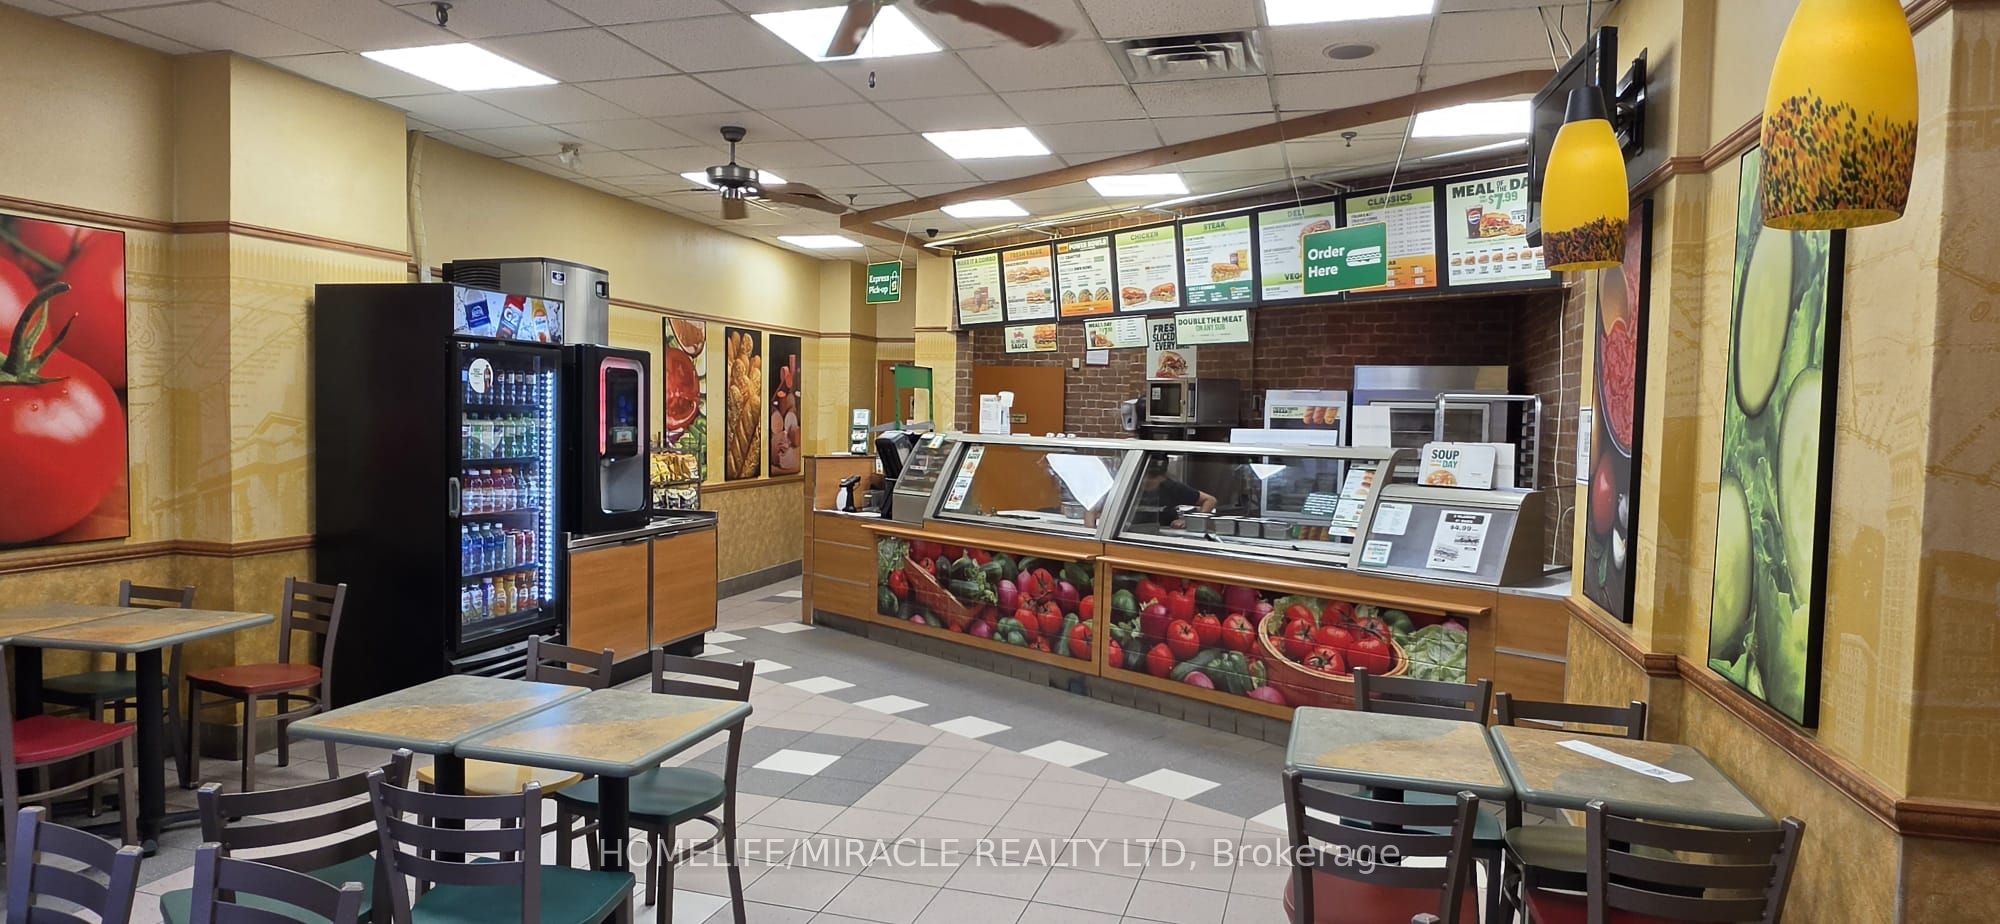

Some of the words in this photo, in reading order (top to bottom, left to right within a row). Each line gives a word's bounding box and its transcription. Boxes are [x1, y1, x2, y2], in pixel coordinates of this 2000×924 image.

[1452, 181, 1495, 199] MEAL
[1509, 176, 1529, 191] DA
[1367, 193, 1413, 206] CLASSICS
[1488, 191, 1518, 210] $7.99
[1287, 208, 1305, 217] DELI
[1203, 221, 1226, 231] STEAK
[1130, 231, 1159, 241] CHICKEN
[1308, 245, 1345, 261] Order
[1308, 265, 1339, 278] Here
[869, 275, 890, 284] Express
[868, 286, 888, 295] Pick-up
[1178, 316, 1207, 326] DOUBLE
[1207, 316, 1223, 324] THE
[1223, 314, 1242, 323] MEAT
[1153, 323, 1174, 333] FRES
[1195, 324, 1204, 332] ON
[1204, 323, 1214, 331] ANY
[1214, 322, 1226, 331] SUB
[1152, 332, 1174, 342] SLICED
[1431, 449, 1461, 461] SOUP
[1442, 459, 1458, 469] DAY
[1449, 524, 1473, 533] $4.99
